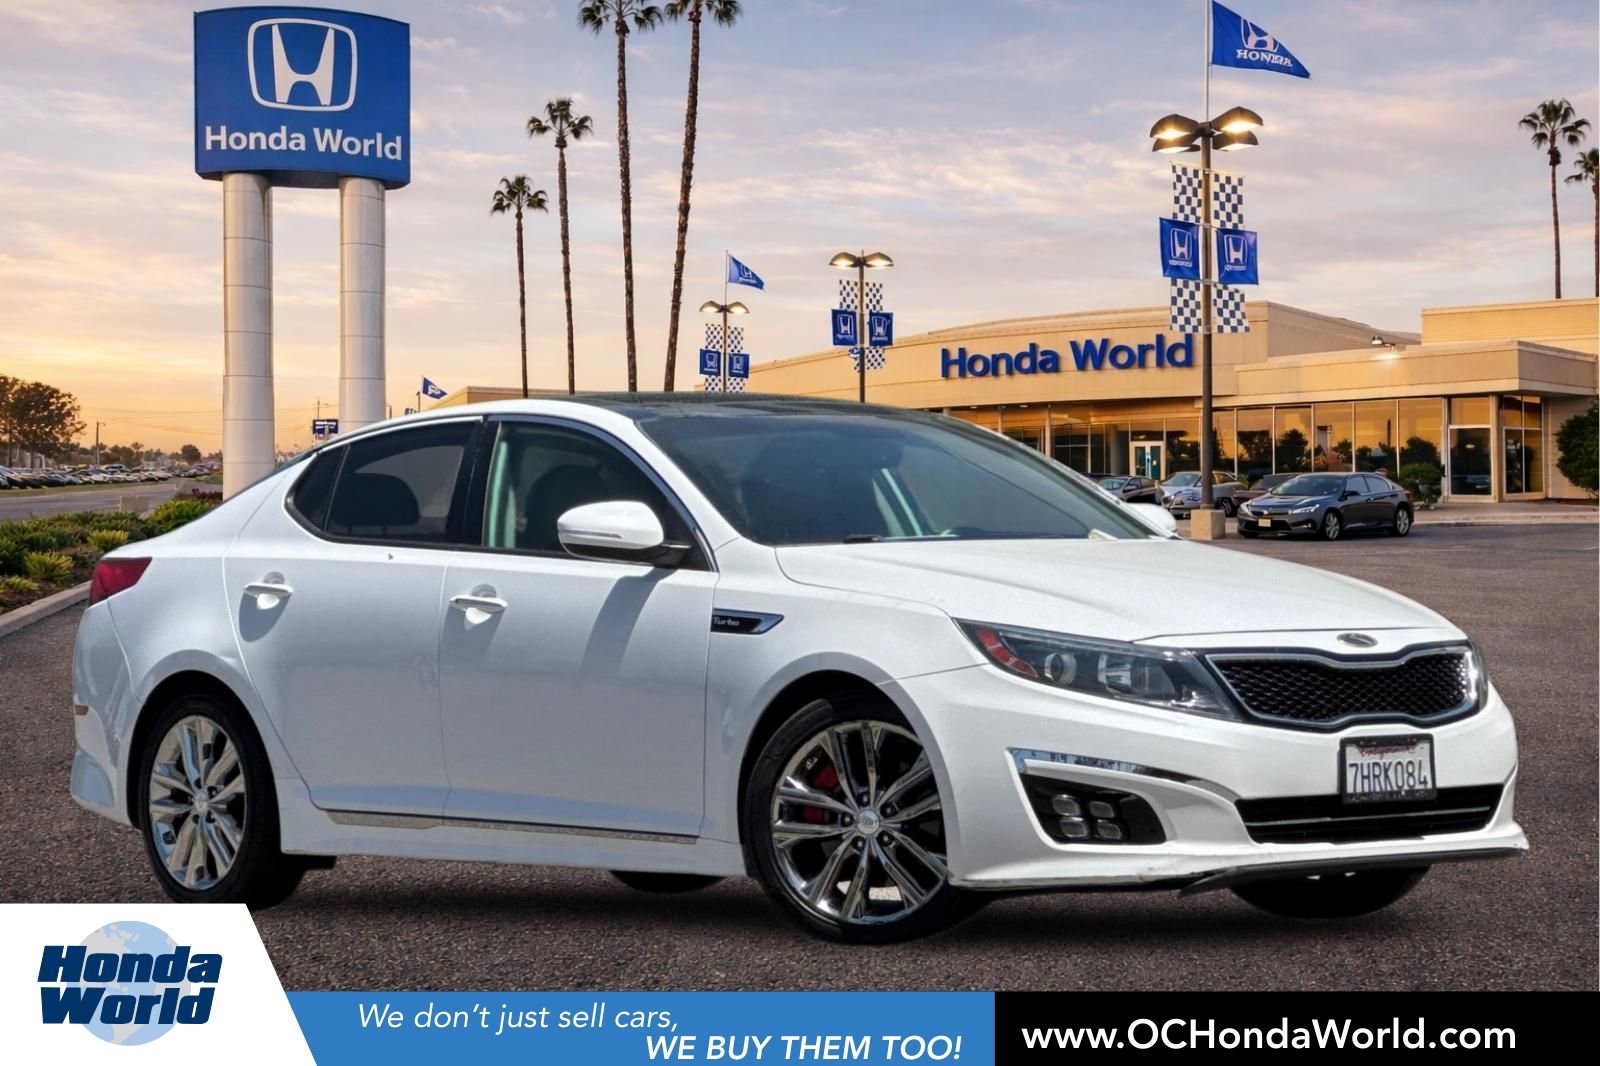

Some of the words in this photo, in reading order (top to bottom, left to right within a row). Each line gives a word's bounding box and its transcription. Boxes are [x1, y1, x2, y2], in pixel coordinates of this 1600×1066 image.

[205, 125, 306, 151] Honda
[313, 127, 402, 161] World
[941, 342, 1060, 378] Honda
[1070, 333, 1194, 371] World
[712, 616, 740, 626] Turbo
[1349, 760, 1428, 793] 7HRK084
